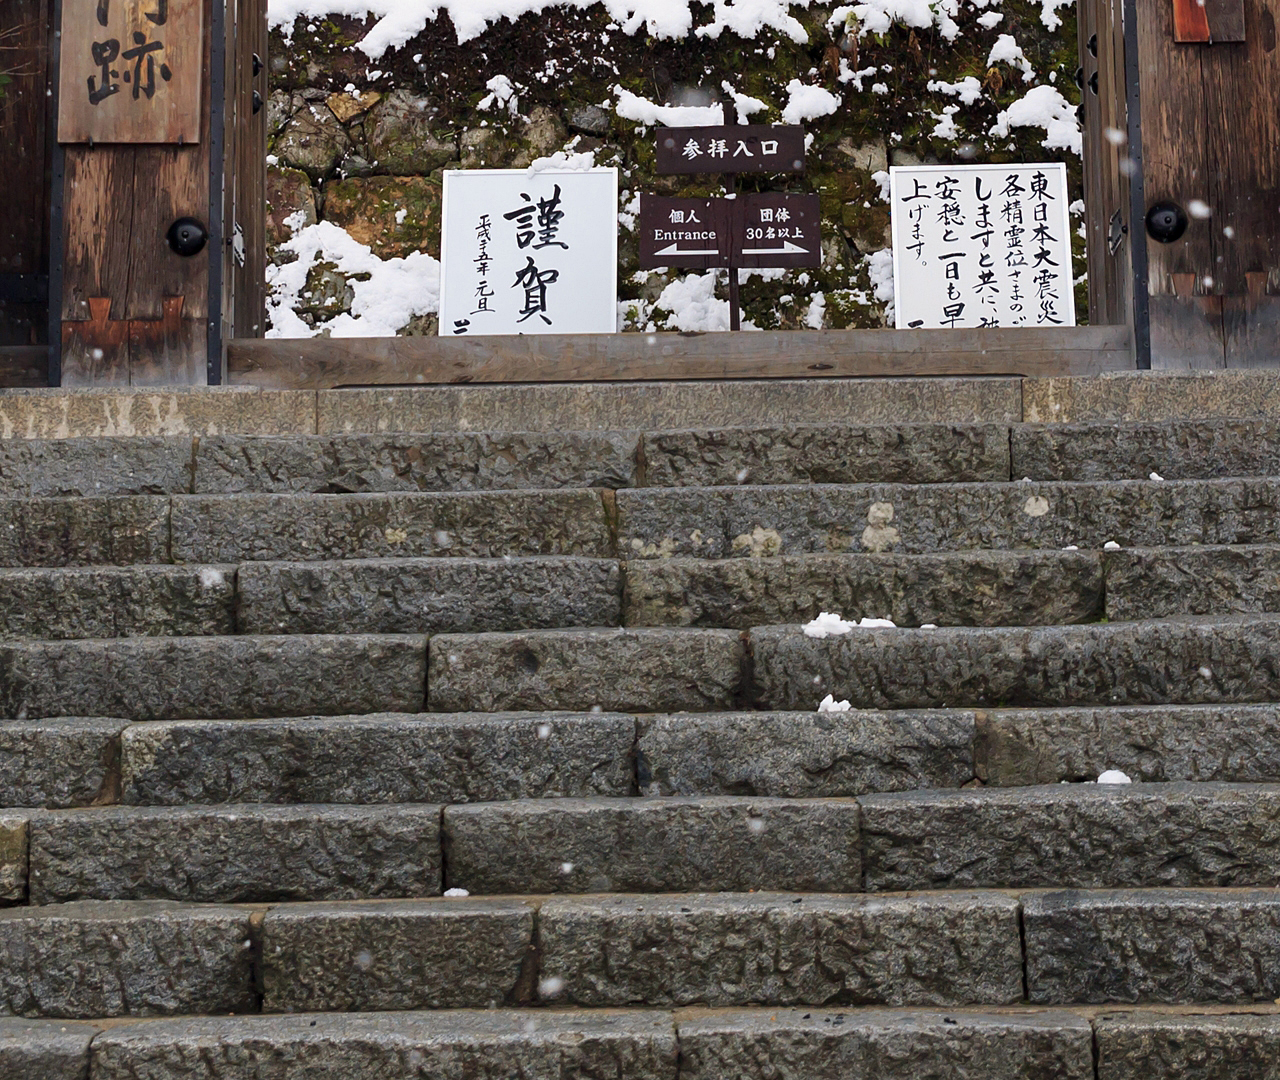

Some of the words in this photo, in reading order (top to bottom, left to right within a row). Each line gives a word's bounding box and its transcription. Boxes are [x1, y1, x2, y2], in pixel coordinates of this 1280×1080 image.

[682, 138, 779, 160] 参拝入口
[669, 209, 701, 224] 個人
[760, 208, 791, 222] 団体
[901, 178, 932, 267] 上げます。
[654, 229, 716, 241] Entrance
[746, 227, 804, 240] 30名以上
[503, 184, 569, 325] 謹賀
[935, 176, 967, 328] 安穏と一日も早
[1027, 170, 1065, 324] 東日本大震災
